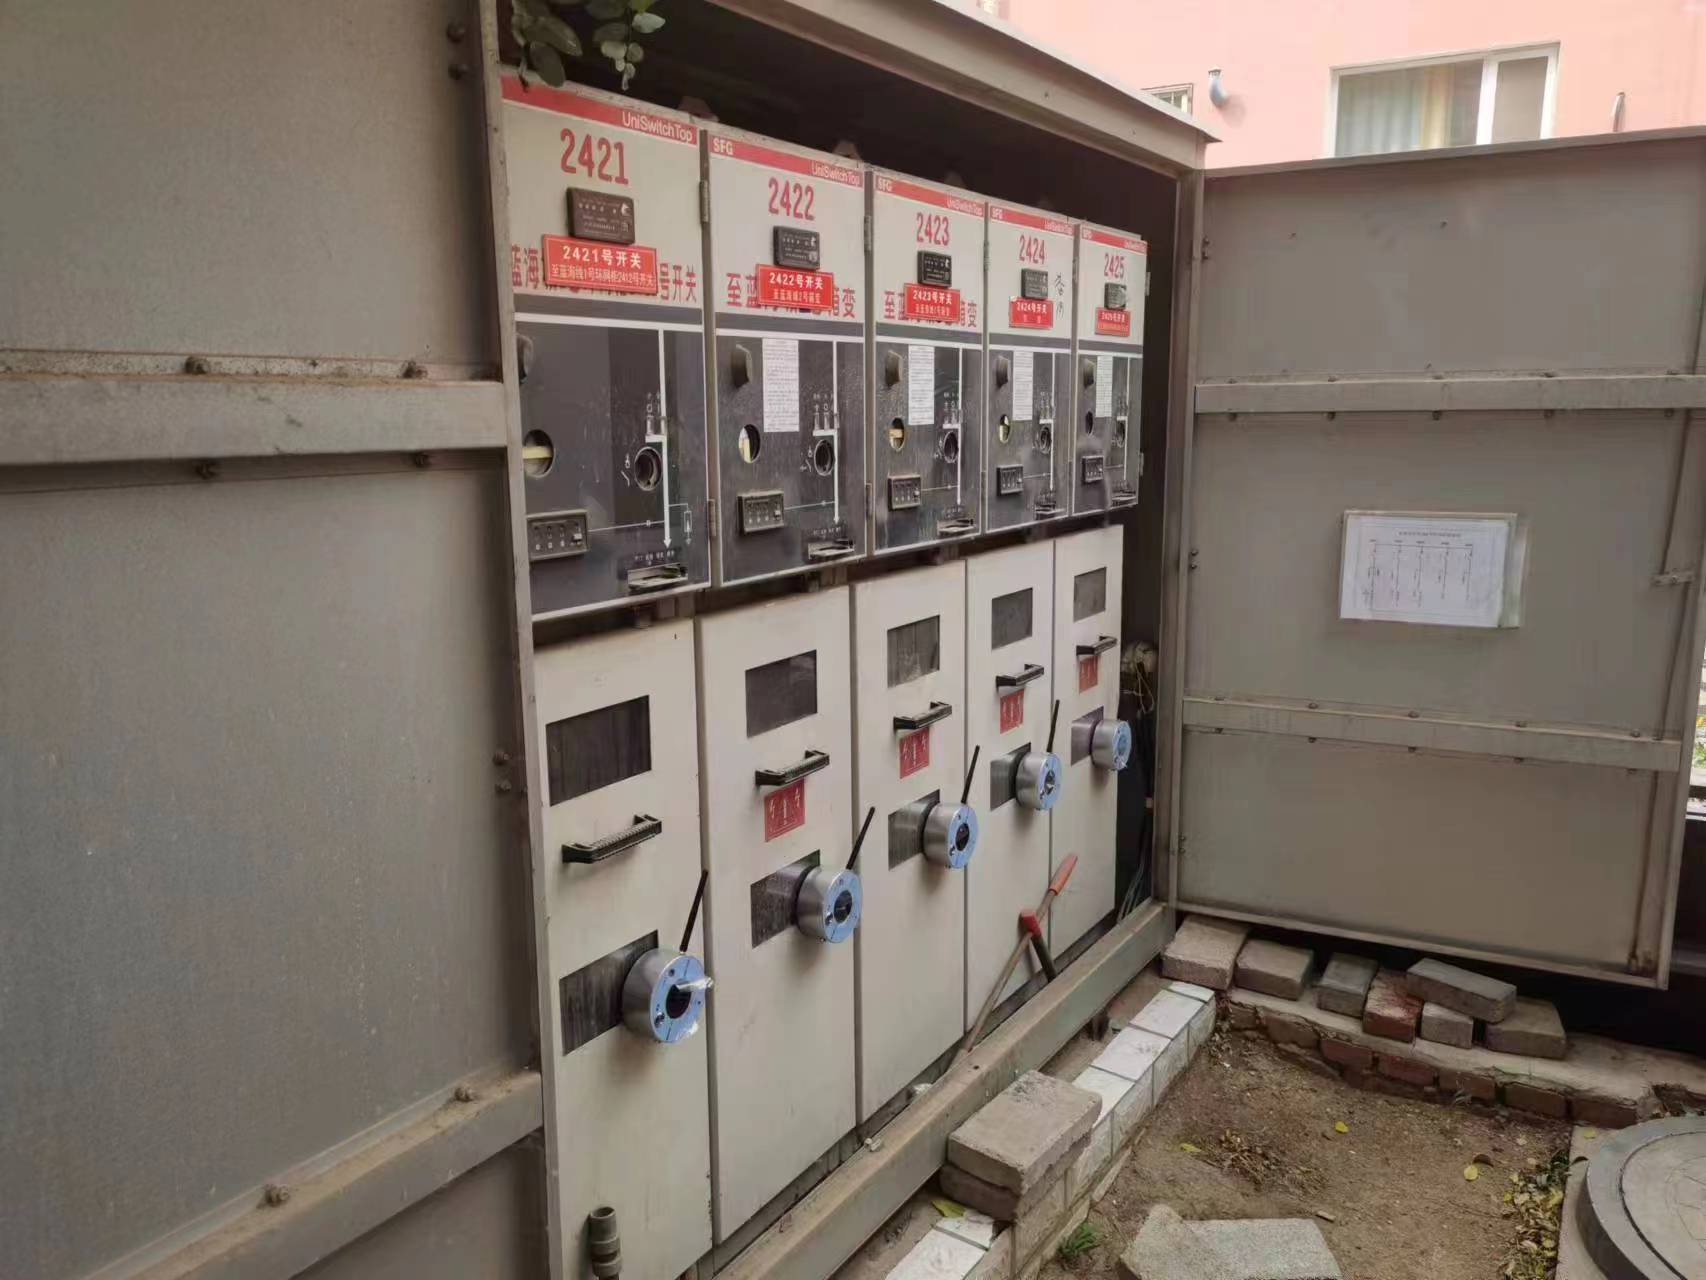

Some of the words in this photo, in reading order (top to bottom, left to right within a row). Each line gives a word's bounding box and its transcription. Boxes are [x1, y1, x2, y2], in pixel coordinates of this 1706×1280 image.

[622, 111, 693, 142] UniSwitchTop
[560, 127, 629, 184] 2421
[768, 177, 815, 221] 2422
[916, 211, 950, 246] 2423
[562, 245, 642, 269] 2421号开关
[1018, 234, 1046, 265] 2424
[769, 272, 824, 290] 2422号开关
[1104, 252, 1125, 279] 2425
[912, 289, 953, 305] 2423号开关
